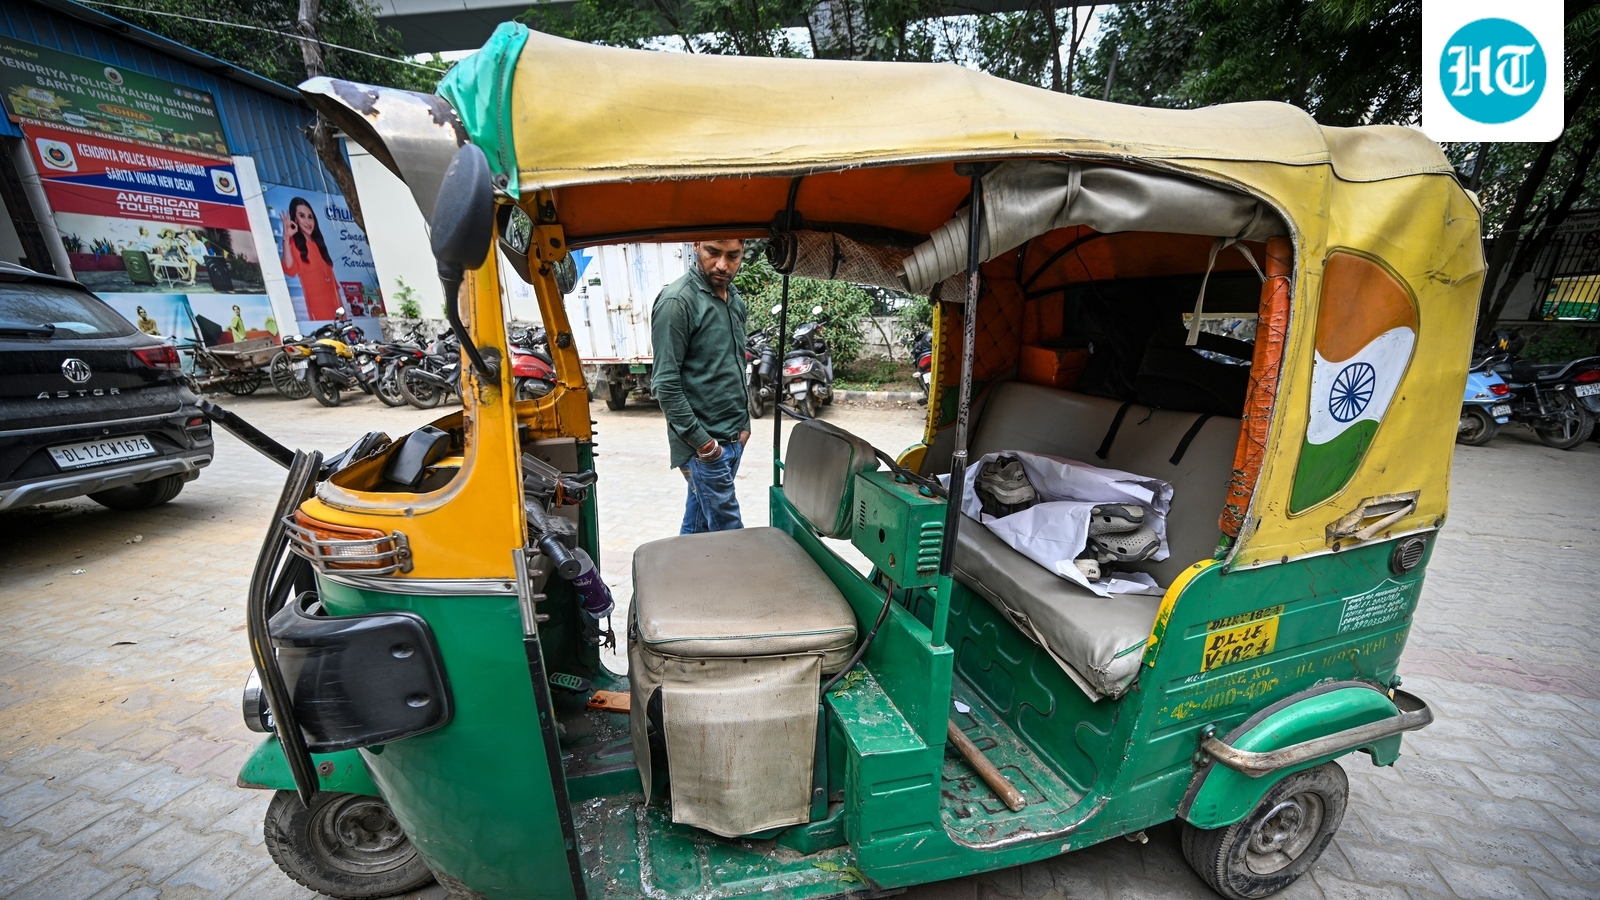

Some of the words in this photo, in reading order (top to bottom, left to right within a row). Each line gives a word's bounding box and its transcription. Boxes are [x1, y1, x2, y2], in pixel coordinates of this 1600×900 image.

[0, 56, 68, 80] KENDRIYA
[70, 73, 117, 93] POLICE
[119, 86, 164, 105] KALYAN
[166, 98, 215, 117] BHANDAR
[36, 75, 86, 96] SARITA
[87, 88, 127, 105] VIHAR
[135, 100, 161, 113] NEW
[163, 107, 194, 121] DELHI
[105, 105, 147, 121] SOHNA
[20, 117, 42, 127] FOR
[94, 131, 135, 145] QUERIES
[75, 143, 119, 164] KENDRIYA
[118, 150, 147, 167] POLICE
[146, 155, 175, 173] KALYAN
[174, 160, 207, 178] BHANDAR
[105, 167, 135, 184] SARITA
[134, 171, 158, 187] VIHAR
[158, 175, 174, 190] NEW
[175, 178, 196, 193] DELHI
[116, 192, 199, 210] AMERICAN
[116, 201, 201, 219] TOURISTER
[350, 244, 364, 257] Ka
[342, 256, 376, 269] Karisma
[37, 387, 121, 400] ASTOR
[61, 438, 150, 462] DL12CW1676
